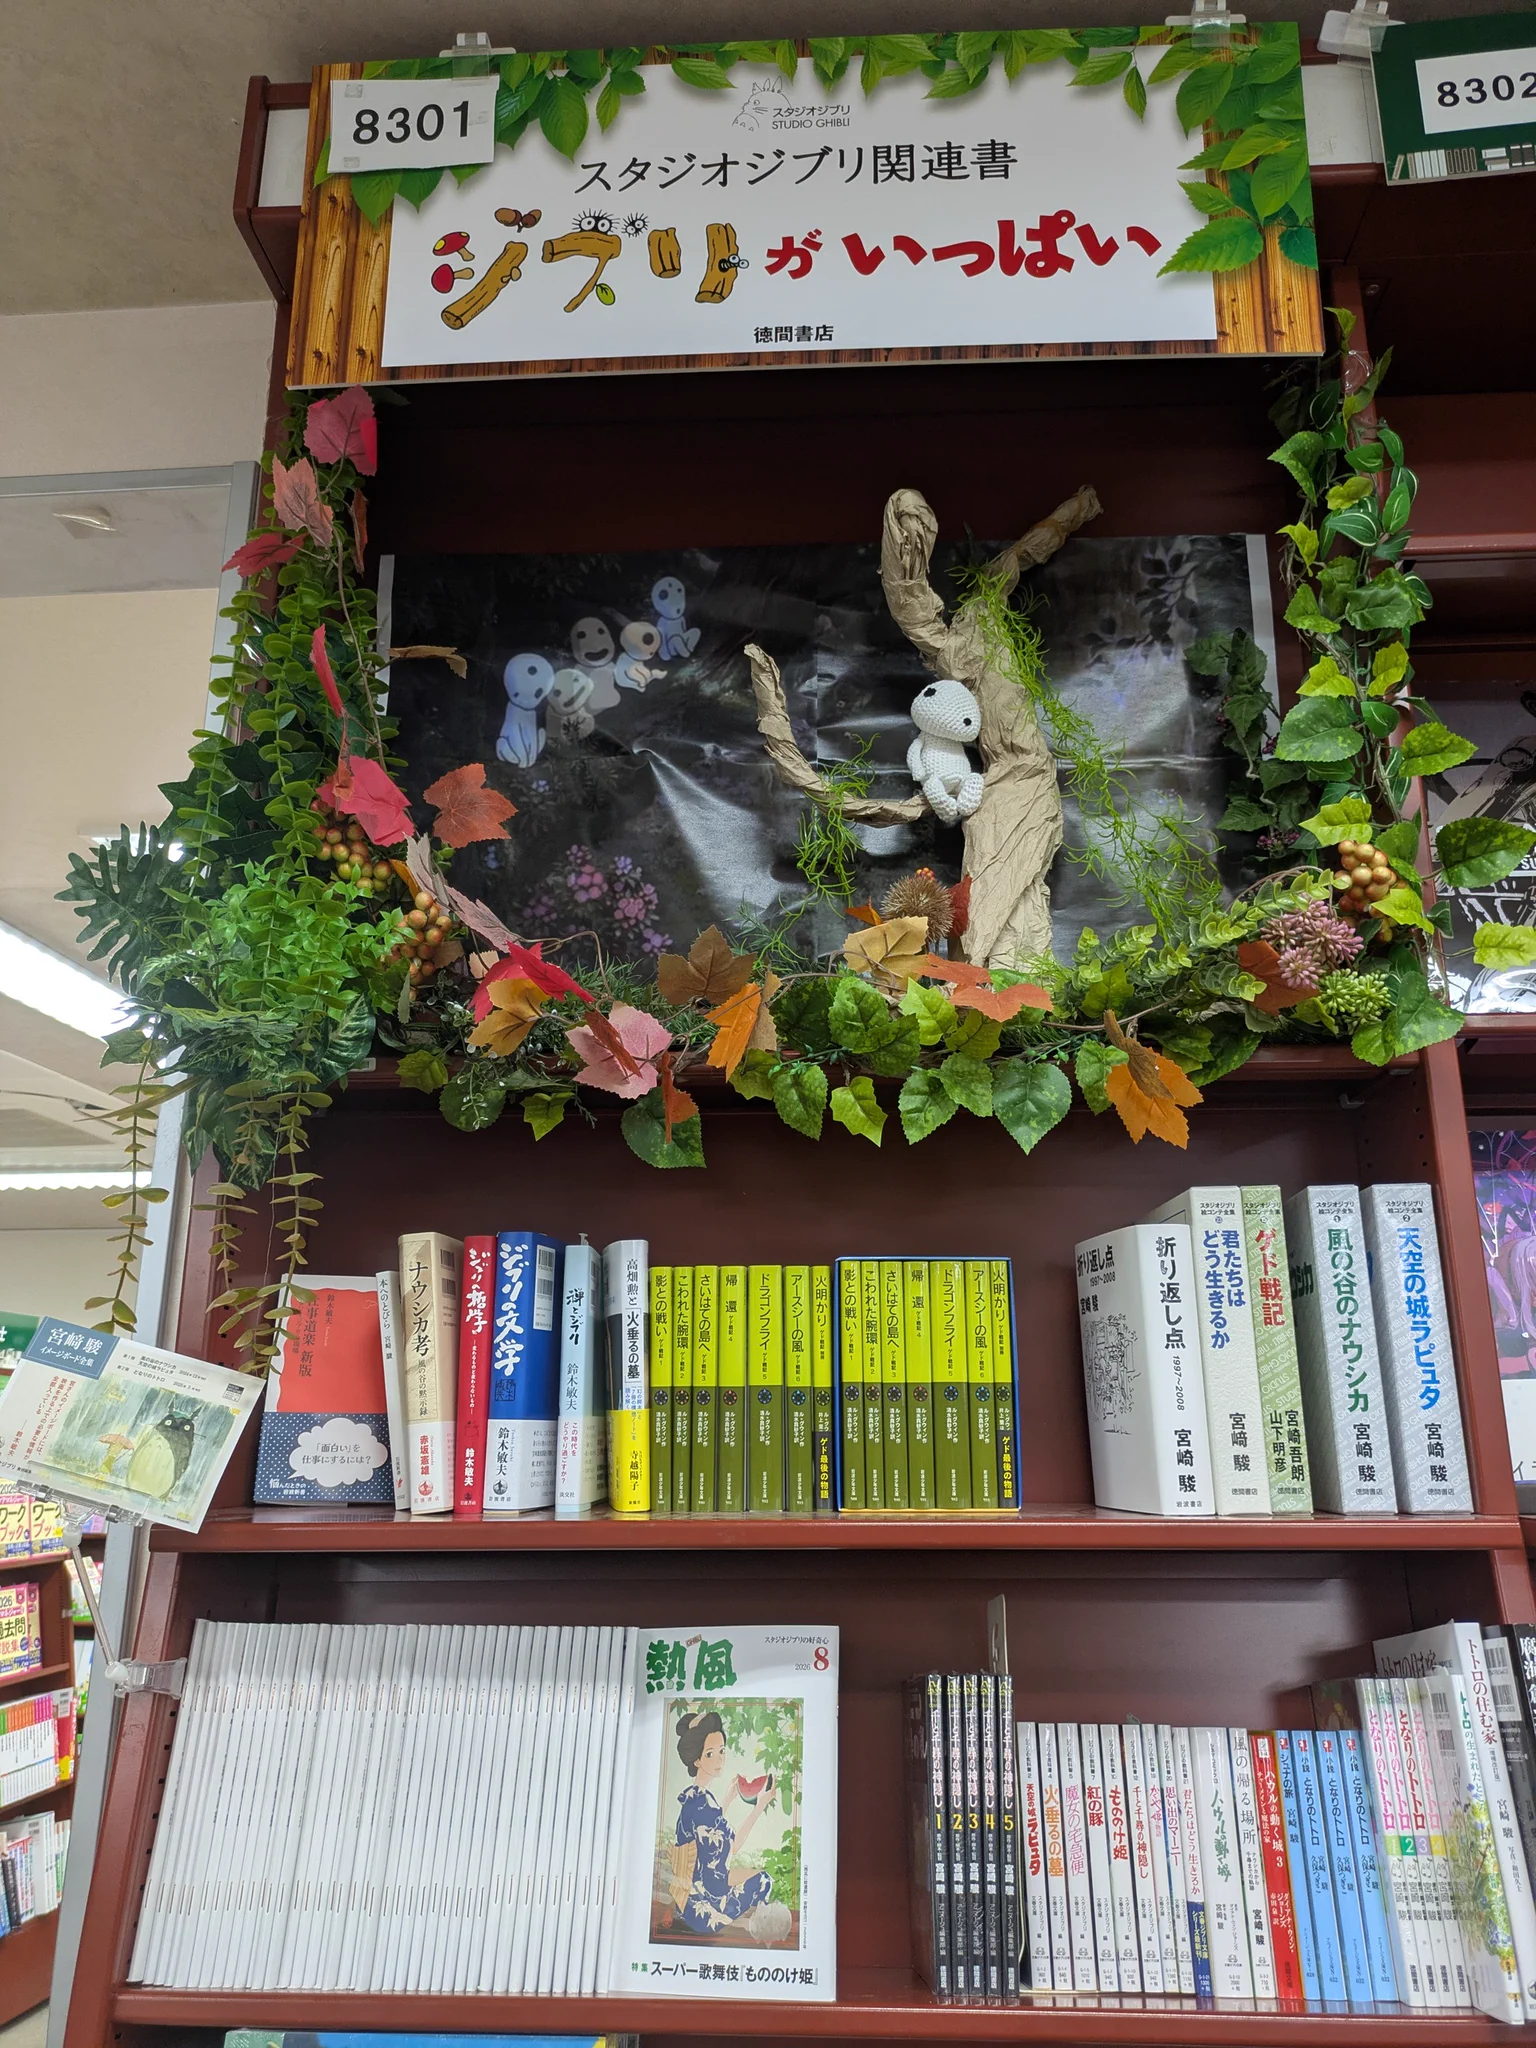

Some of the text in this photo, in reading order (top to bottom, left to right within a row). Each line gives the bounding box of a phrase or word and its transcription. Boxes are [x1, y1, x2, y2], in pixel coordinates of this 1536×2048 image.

[772, 104, 851, 118] スタジオジブリ
[1437, 72, 1536, 107] 8302
[352, 101, 471, 145] 8301
[772, 117, 850, 130] STUDIO GHIBLI
[574, 139, 1019, 194] スタジオジブリ関連書
[754, 325, 834, 344] 徳間書店
[465, 1248, 491, 1335] ジブリの哲学
[911, 1269, 924, 1309] 帰還
[1077, 1245, 1114, 1277] 折り返し点
[1203, 1229, 1230, 1349] どう生きるか
[1221, 1230, 1246, 1307] 君たちは
[1255, 1228, 1285, 1326] ゲド戦記
[324, 1294, 336, 1325] 鈴木敏夫
[379, 1279, 391, 1329] 本へのとびら
[409, 1262, 431, 1357] ナウシカ考
[493, 1243, 530, 1377] ジブリの文学
[566, 1288, 585, 1346] 禅とジブリ
[655, 1275, 668, 1336] 影との戦い
[677, 1275, 690, 1349] こわれた腕環
[698, 1274, 711, 1352] さいはての島へ
[725, 1274, 738, 1313] 帰還
[759, 1273, 771, 1351] ドラゴンフライ
[791, 1274, 804, 1353] アースシーの風
[815, 1275, 828, 1327] 火明かり
[844, 1269, 857, 1331] 影との戦い
[865, 1270, 878, 1345] こわれた腕環
[886, 1270, 899, 1348] さいはての島へ
[942, 1268, 956, 1347] ドラゴンフライ
[973, 1269, 987, 1349] アースシーの風
[993, 1269, 1006, 1322] 火明かり
[1156, 1236, 1186, 1350] 折り返し点
[1327, 1228, 1369, 1413] 風の谷のナウシカ
[1397, 1227, 1441, 1410] 天空の城ラピュタ
[40, 1346, 95, 1367] イメージボード全集
[133, 1370, 166, 1383] となりのトトロ
[298, 1350, 314, 1377] 新版
[566, 1363, 579, 1411] 鈴木敏夫
[315, 1443, 361, 1453] 「面白い」を
[419, 1434, 430, 1476] 赤坂憲雄
[464, 1448, 475, 1486] 鈴木敏夫
[496, 1427, 510, 1477] 鈴木敏夫
[570, 1422, 578, 1457] この時代を
[819, 1437, 829, 1499] ゲド最後の物語
[1002, 1436, 1013, 1498] ゲド最後の物語
[1270, 1410, 1287, 1473] 山下明彦
[1285, 1410, 1305, 1482] 宮崎吾朗
[33, 1519, 53, 1538] ブッ
[645, 1639, 737, 1694] 熱風
[764, 1636, 830, 1645] スタジオジブリの好奇心
[795, 1663, 811, 1671] 2026
[813, 1646, 830, 1671] 8
[1468, 1639, 1498, 1745] トトロの住む家
[931, 1709, 943, 1809] 千と千尋の神隠し
[950, 1710, 961, 1809] 千と千尋の神隠し
[966, 1709, 978, 1809] 千と千尋の神隠し
[983, 1709, 994, 1809] 千と千尋の神隠し
[1002, 1710, 1013, 1809] 千と千尋の神隠し
[1280, 1754, 1294, 1799] シュナの旅
[1369, 1709, 1395, 1830] となりのトトロ
[1384, 1709, 1410, 1830] となりのトトロ
[1399, 1709, 1426, 1831] となりのトトロ
[1413, 1709, 1441, 1830] となりのトトロ
[936, 1814, 942, 1829] 1
[968, 1814, 979, 1829] 3
[1086, 1786, 1104, 1827] 紅の豚
[1233, 1736, 1257, 1845] 風の帰る場所
[1265, 1771, 1284, 1852] ハウルの動く城
[1301, 1756, 1320, 1846] 小説 となりのトトロ
[1326, 1757, 1345, 1847] 小説 となりのトトロ
[1350, 1755, 1369, 1845] 小説 となりのトトロ
[953, 1814, 963, 1830] 2
[985, 1814, 995, 1830] 4
[1004, 1815, 1014, 1831] 5
[1026, 1783, 1041, 1876] 天空の城ラピュタ
[1044, 1784, 1063, 1877] 火垂るの墓
[1065, 1784, 1085, 1876] 魔女の宅急便
[1109, 1785, 1128, 1860] もののけ姫
[1133, 1786, 1148, 1879] 千と千尋の神隠し
[1165, 1786, 1181, 1866] 思い出のマーニー
[1184, 1789, 1201, 1895] 君たちはどう生きるか
[1211, 1789, 1231, 1882] ハウルの動く城
[1276, 1856, 1283, 1868] 3
[1277, 1893, 1287, 1928] ジョーンズ
[631, 1961, 819, 1985] 特集 スーパー歌舞伎『もののけ姫』
